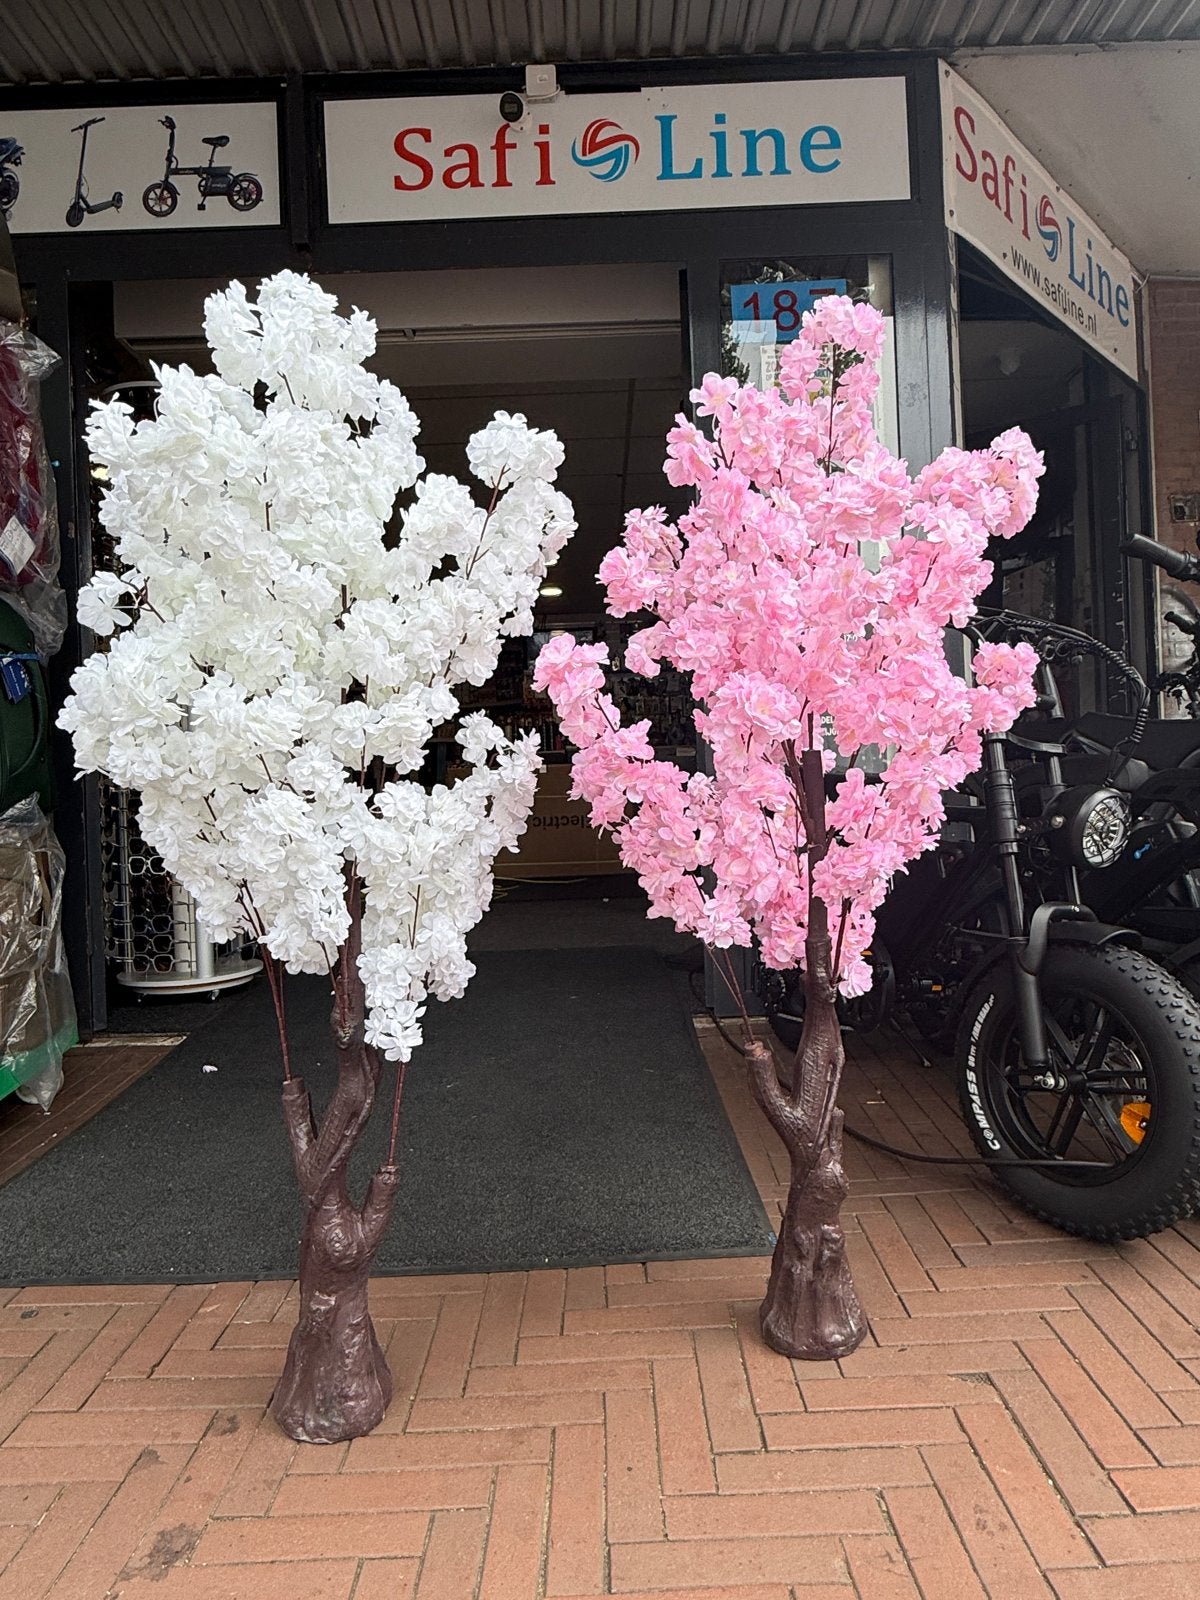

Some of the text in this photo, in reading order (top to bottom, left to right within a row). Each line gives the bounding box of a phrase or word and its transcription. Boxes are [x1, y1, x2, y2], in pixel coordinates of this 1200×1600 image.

[394, 113, 842, 191] Safi Line
[954, 106, 1129, 327] Safi Line
[1011, 246, 1098, 337] www.safiline.nl
[966, 1069, 1001, 1151] COMPASS
